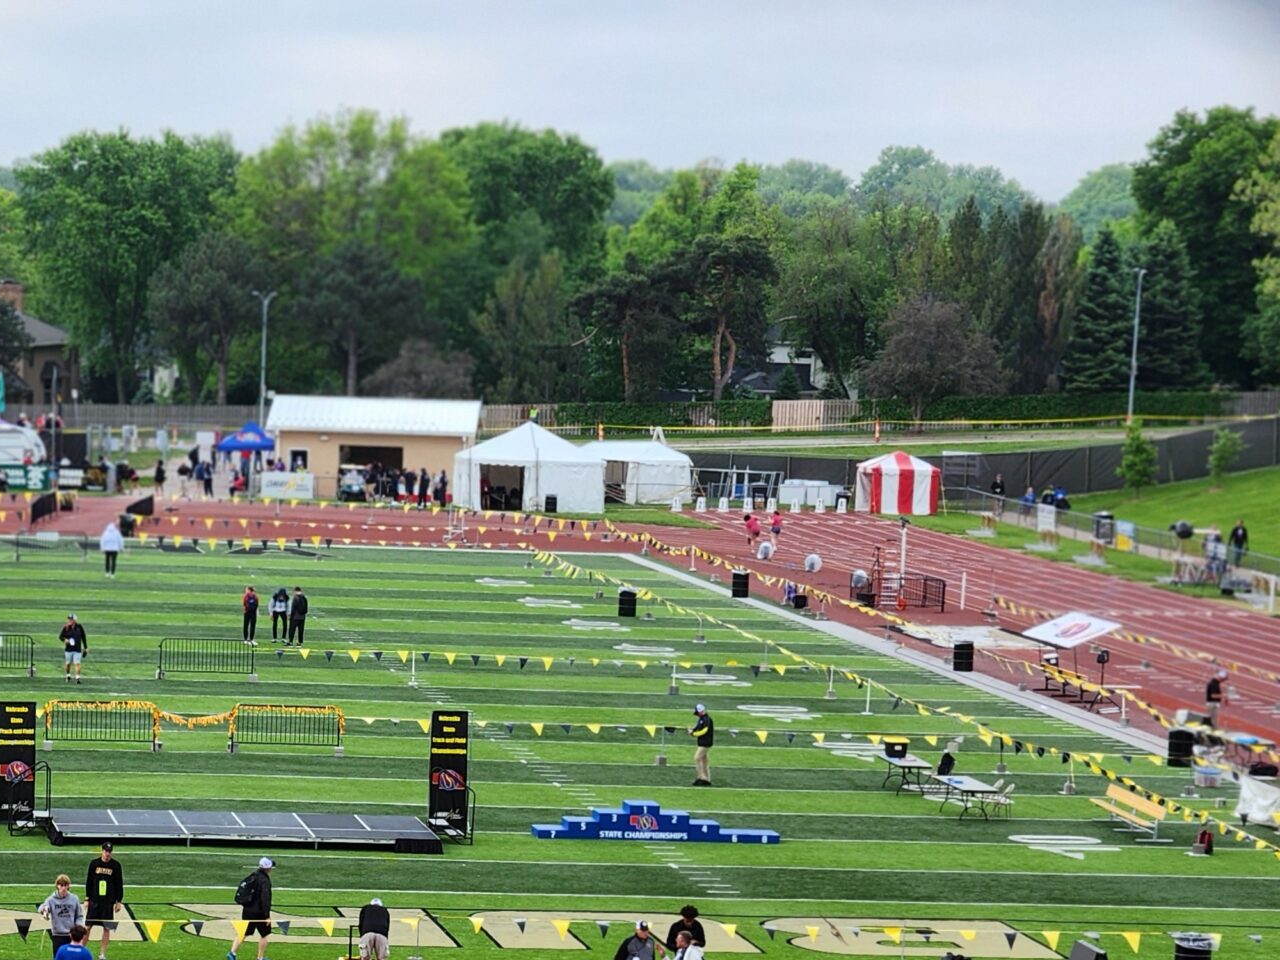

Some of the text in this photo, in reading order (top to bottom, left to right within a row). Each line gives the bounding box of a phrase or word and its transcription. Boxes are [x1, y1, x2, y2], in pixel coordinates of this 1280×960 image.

[643, 806, 647, 814] 1
[612, 814, 617, 823] 3
[671, 815, 677, 824] 2
[580, 822, 587, 831] 5
[701, 824, 707, 833] 4
[599, 830, 688, 840] STATE CHAMPIONSHIPS
